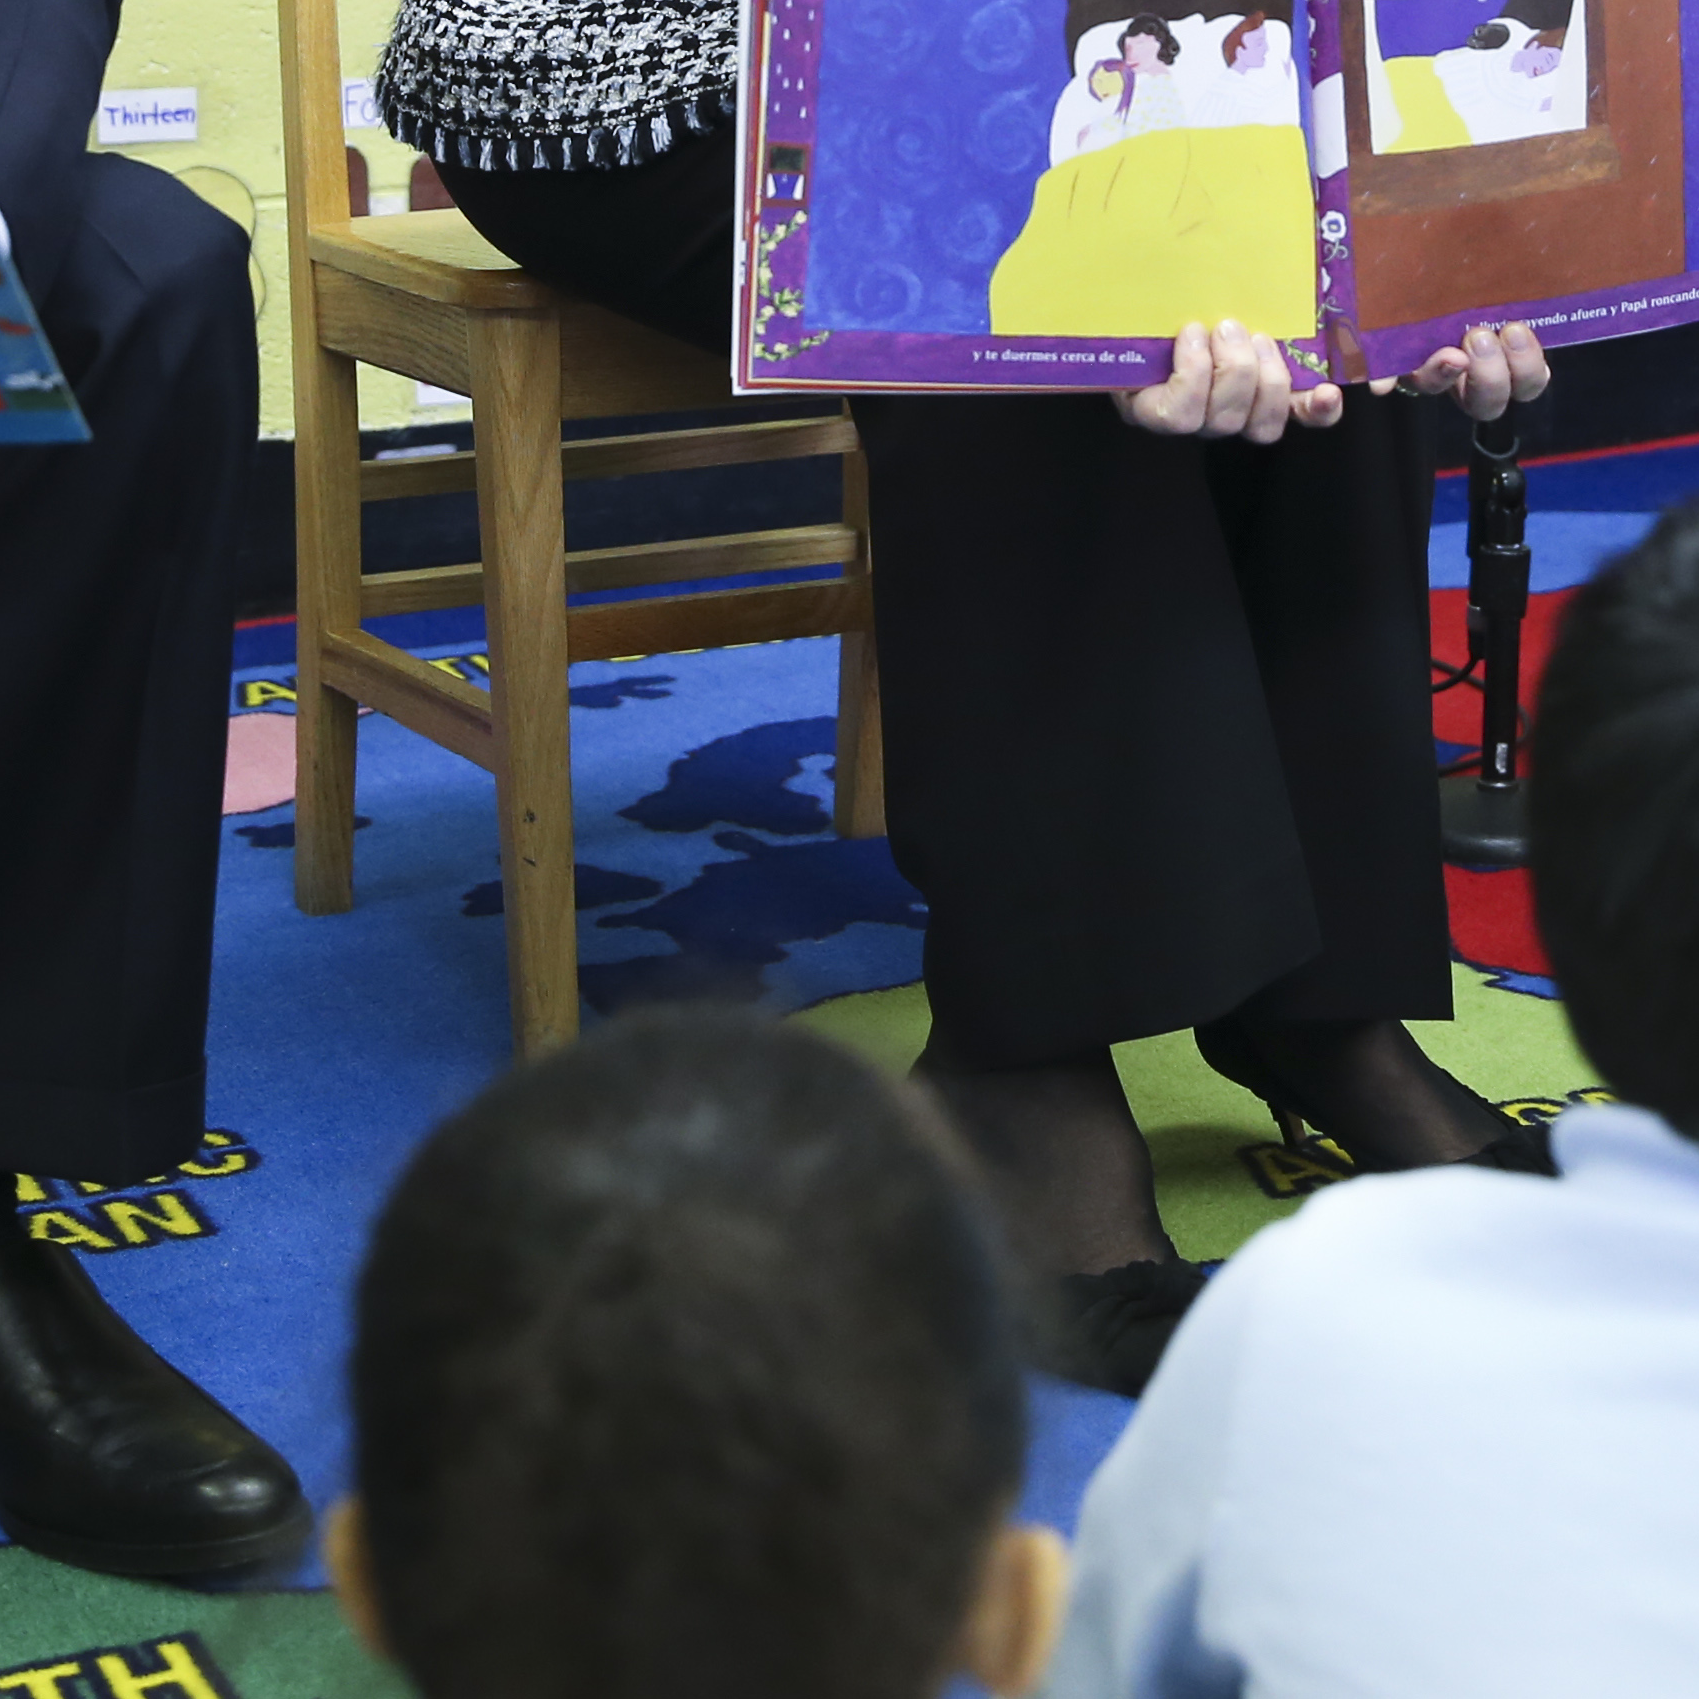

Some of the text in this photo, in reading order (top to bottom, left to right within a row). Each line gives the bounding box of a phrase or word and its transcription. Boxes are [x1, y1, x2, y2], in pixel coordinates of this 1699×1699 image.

[104, 104, 196, 128] Thirteen
[1520, 312, 1568, 330] ayendo
[1570, 306, 1608, 323] afuera
[1610, 305, 1619, 318] y
[972, 351, 983, 363] y
[984, 350, 999, 361] te
[1001, 349, 1058, 362] duermes
[1060, 351, 1096, 363] cerca
[1098, 350, 1116, 363] de
